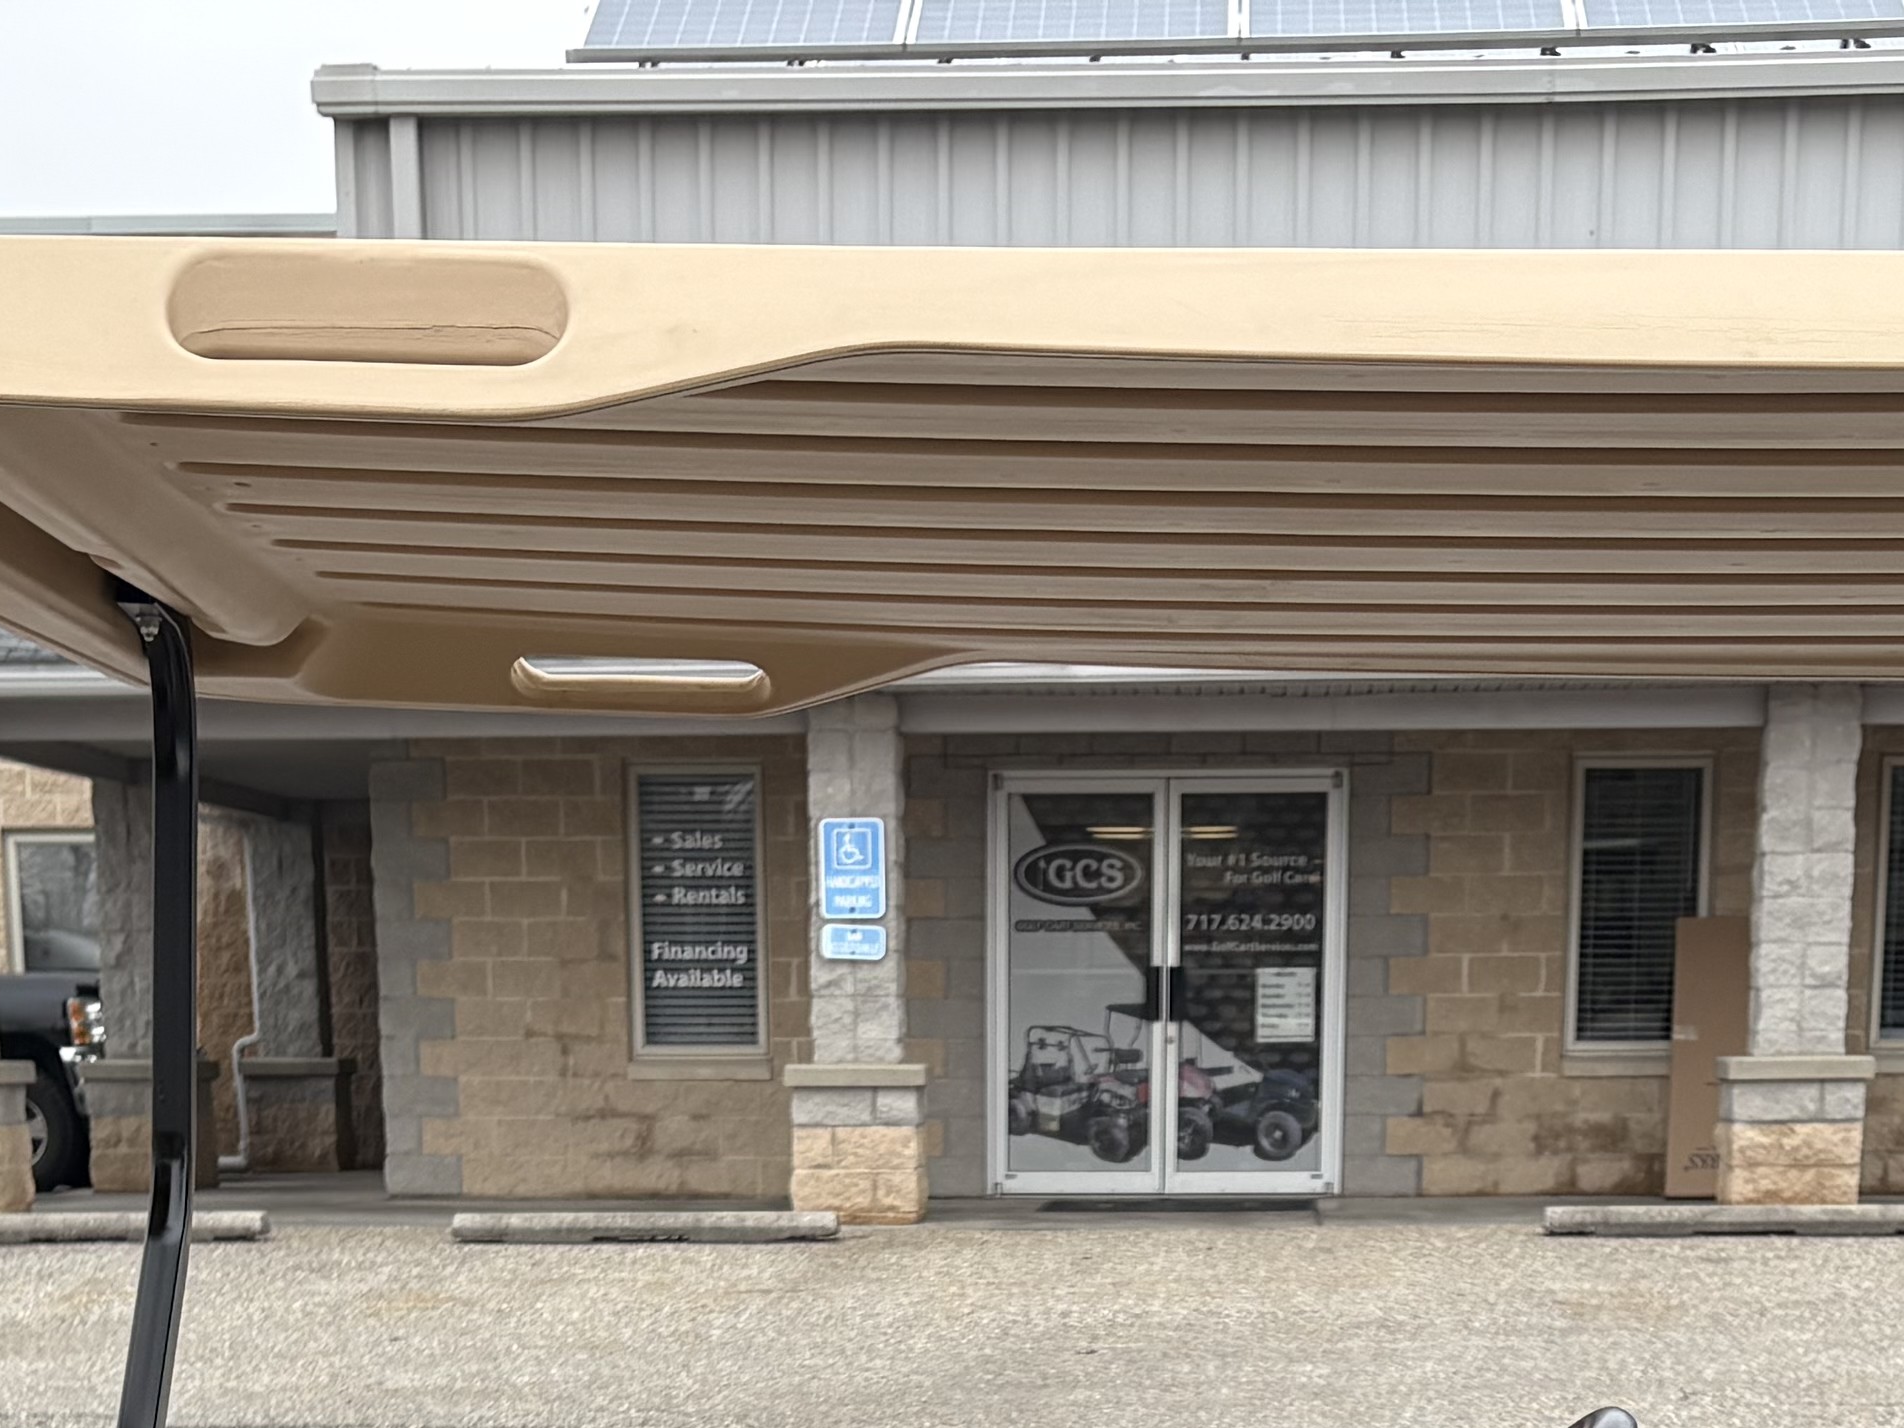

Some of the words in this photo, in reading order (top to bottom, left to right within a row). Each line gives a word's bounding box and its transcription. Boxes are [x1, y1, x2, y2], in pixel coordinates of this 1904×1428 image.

[670, 830, 723, 849] Sales
[671, 858, 744, 877] Service
[1048, 858, 1125, 889] GCS
[671, 886, 746, 905] Rentals
[1185, 913, 1316, 931] 717.624.2900
[651, 941, 748, 965] Financing
[652, 969, 744, 988] Available
